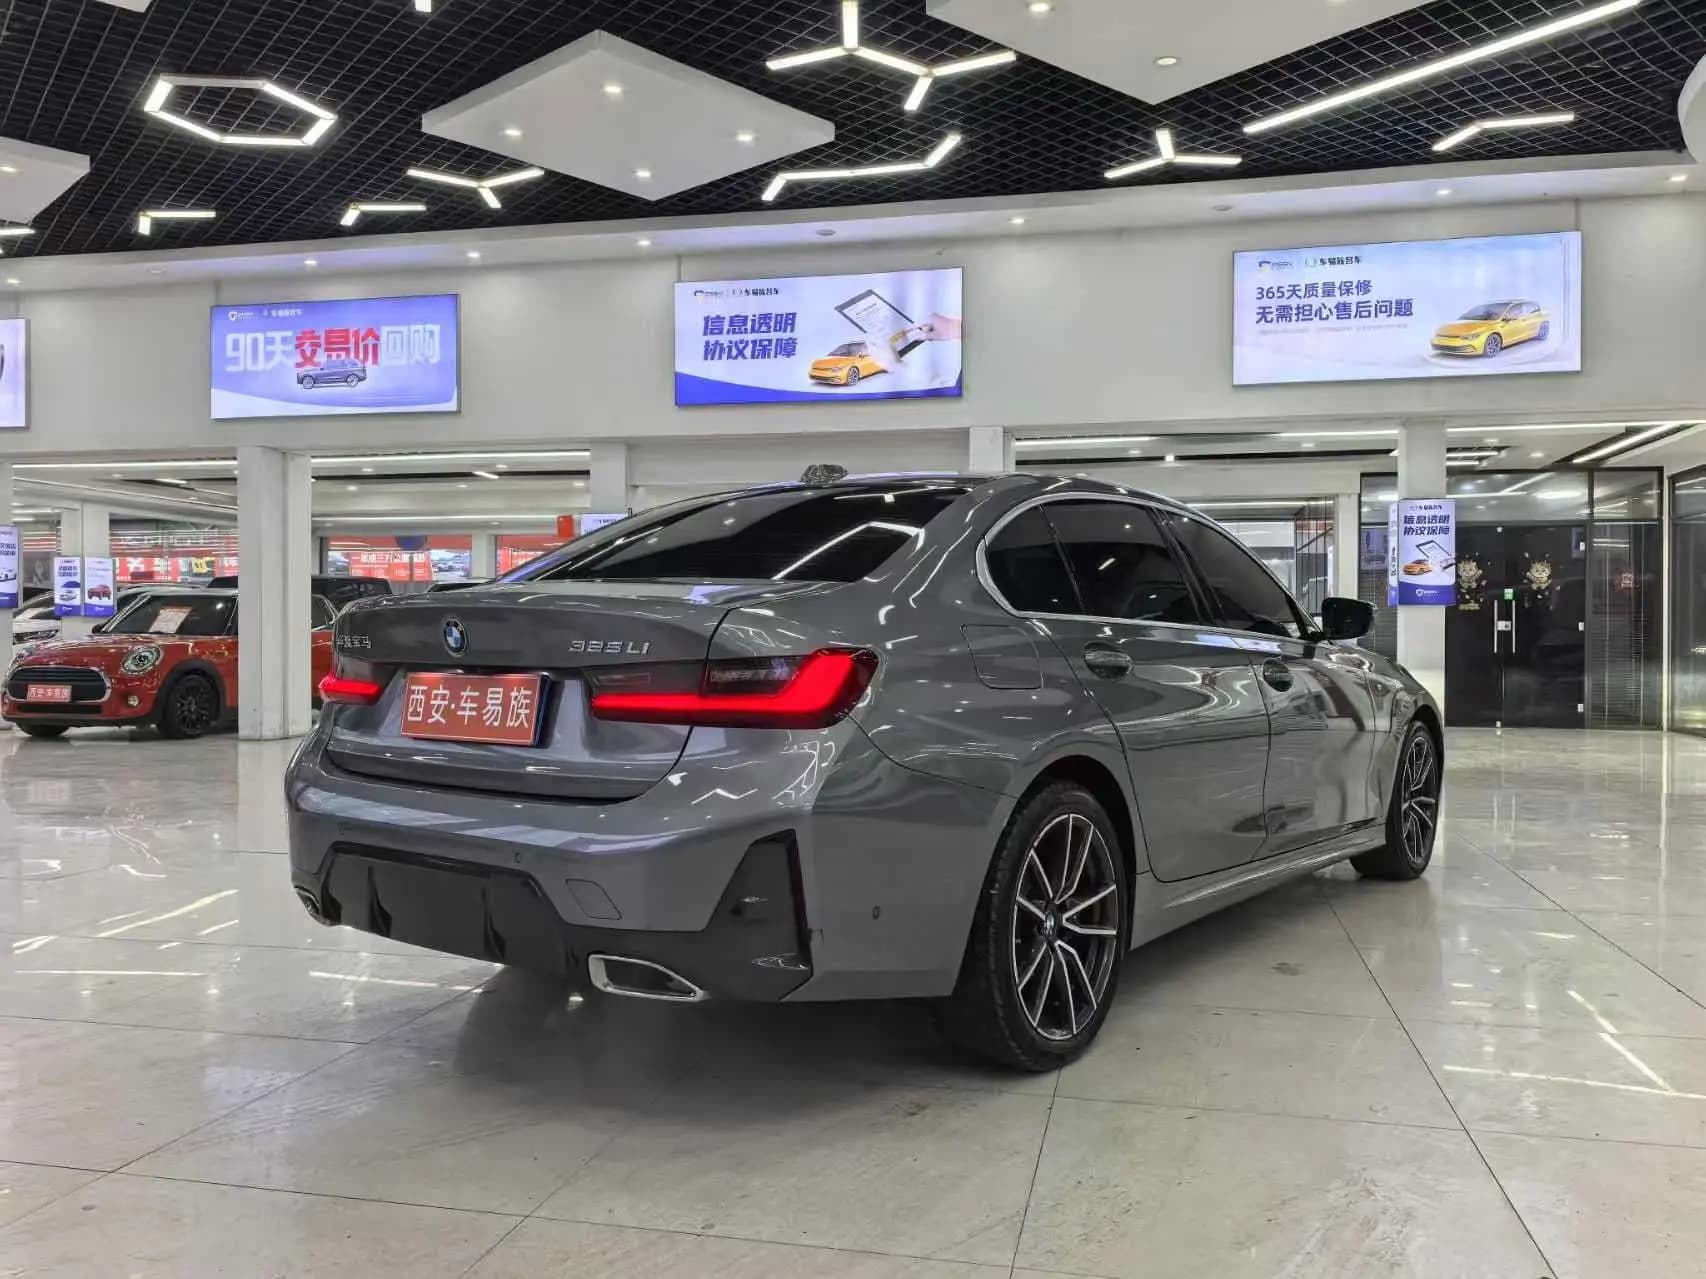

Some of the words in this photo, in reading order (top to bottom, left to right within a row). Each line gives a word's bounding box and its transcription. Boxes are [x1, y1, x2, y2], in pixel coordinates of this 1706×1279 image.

[1256, 280, 1373, 300] 365天质量保修
[1256, 298, 1414, 324] 无需担心售后问题
[703, 312, 797, 336] 信息透明
[703, 337, 798, 360] 协议保障
[407, 684, 533, 729] 西安·车易族
